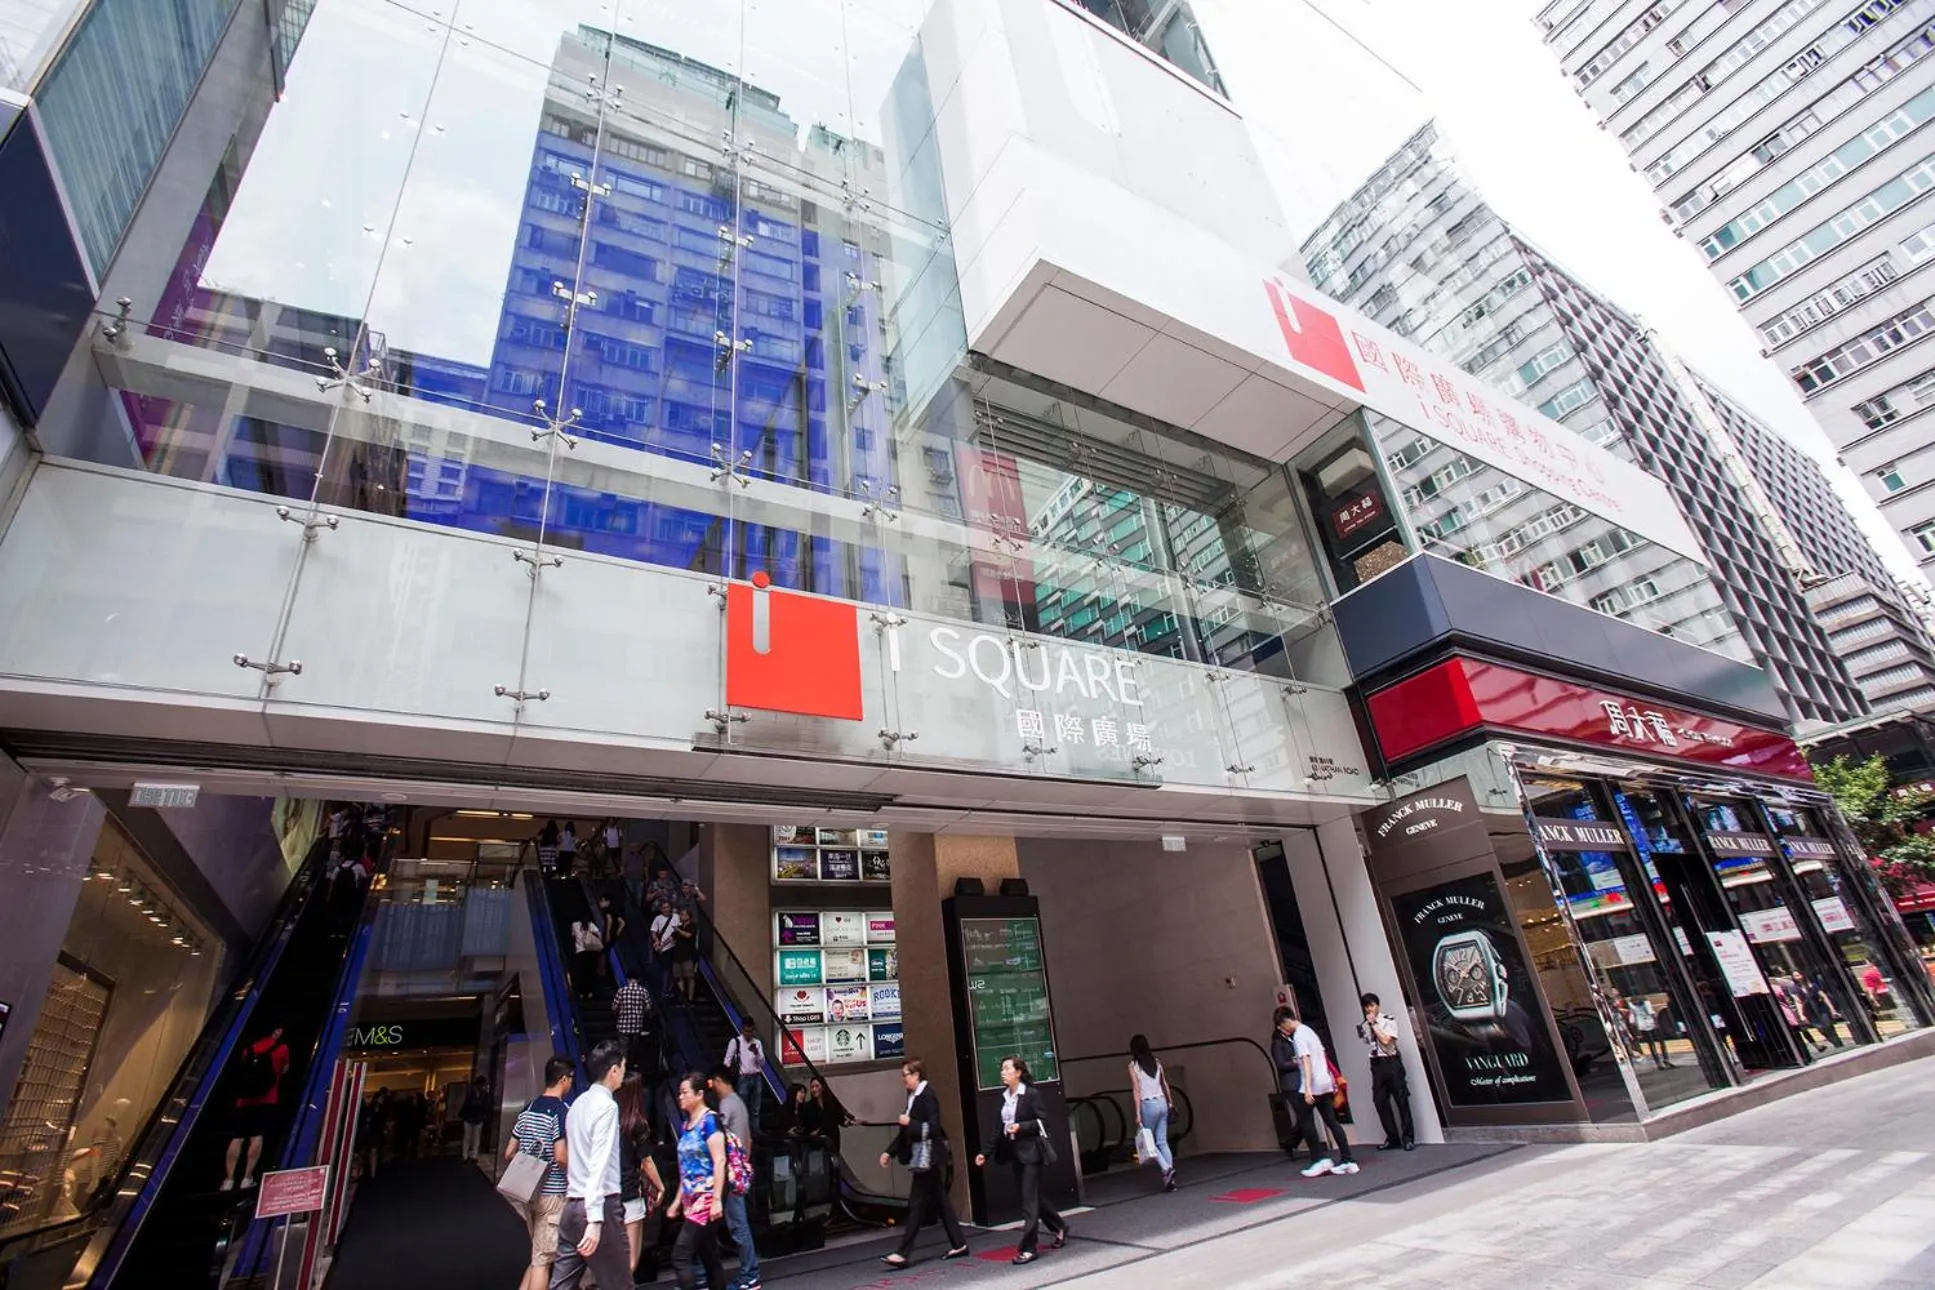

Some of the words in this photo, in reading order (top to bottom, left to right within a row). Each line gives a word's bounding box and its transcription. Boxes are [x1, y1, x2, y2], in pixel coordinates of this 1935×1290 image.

[929, 626, 1144, 707] SQUARE
[1015, 708, 1153, 752] 國際廣場
[1599, 699, 1679, 748] 周大福
[1377, 802, 1414, 838] FRANCK
[1415, 797, 1464, 813] MULLER
[1405, 818, 1438, 836] GENEVE
[1574, 826, 1625, 845] MULLER
[1414, 899, 1444, 924] FRANCK
[1445, 895, 1485, 910] MULLER
[354, 1024, 404, 1046] M&S
[1465, 1052, 1529, 1070] VANGUARD
